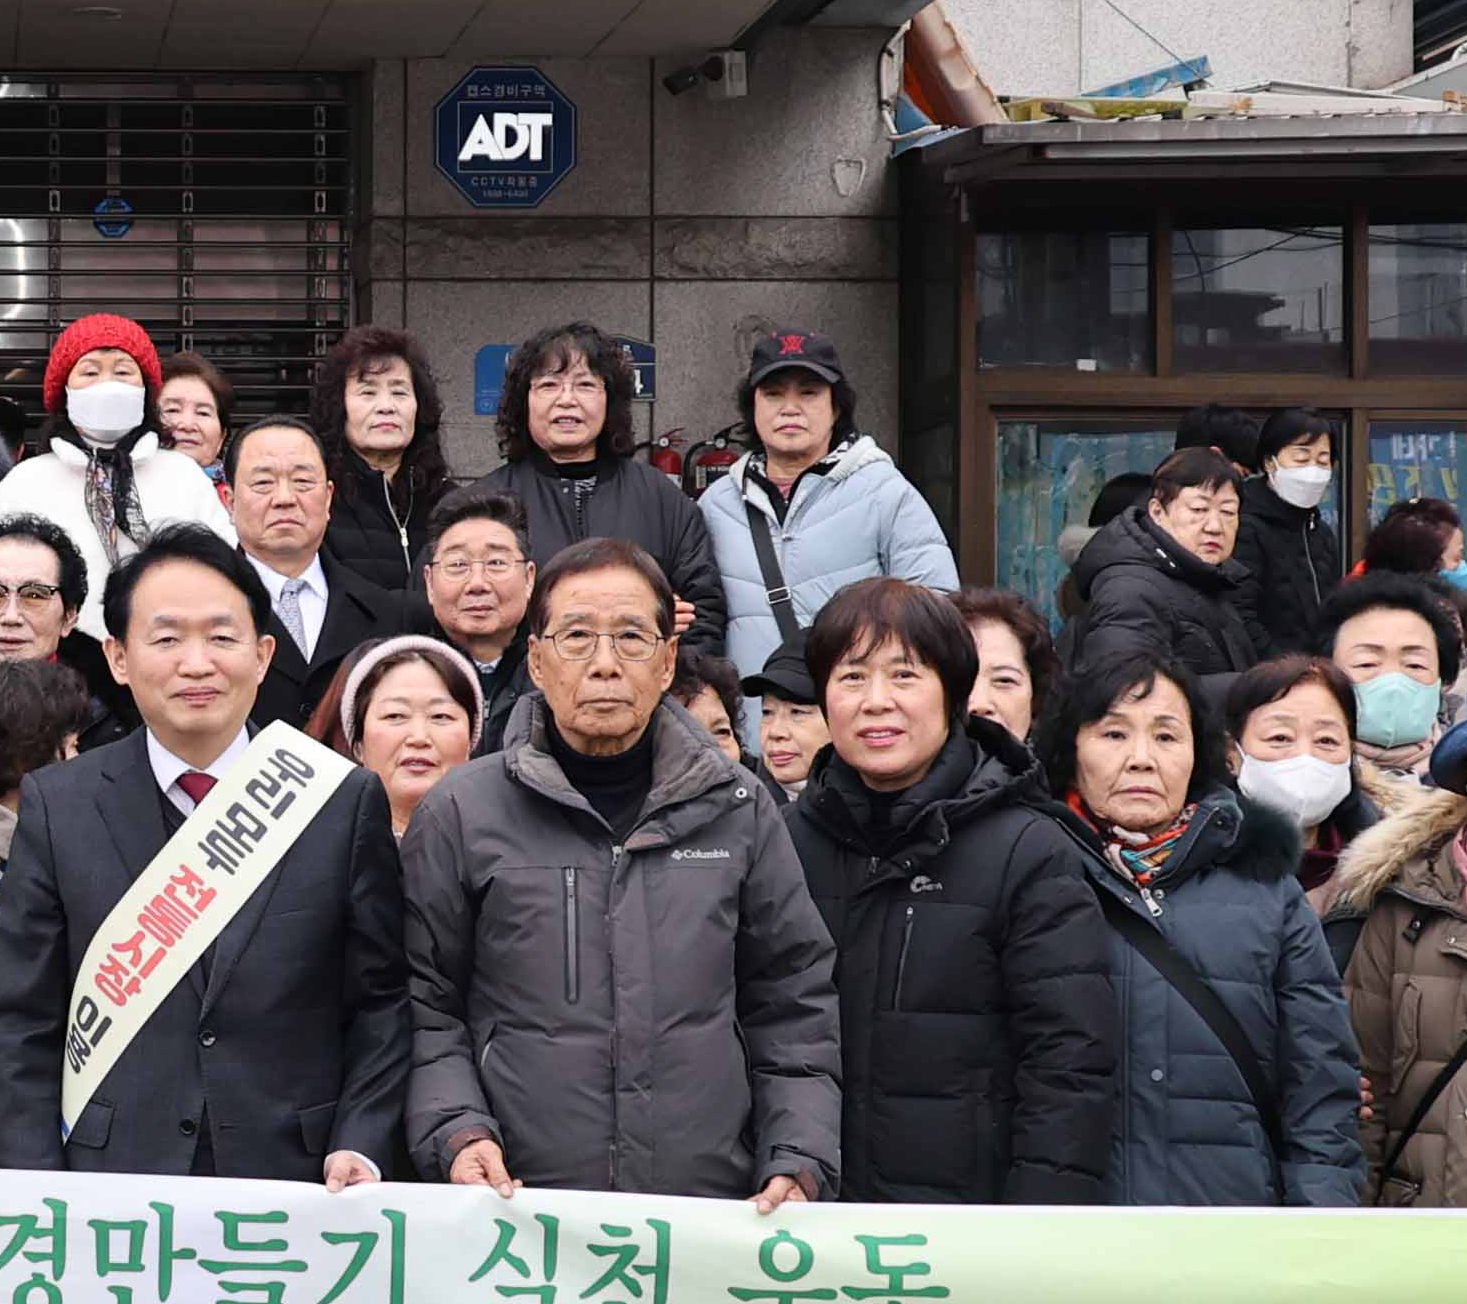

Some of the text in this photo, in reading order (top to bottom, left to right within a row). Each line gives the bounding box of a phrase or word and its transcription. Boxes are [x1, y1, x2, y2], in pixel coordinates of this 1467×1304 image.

[457, 111, 554, 162] ADT
[245, 747, 316, 820] 우리
[197, 801, 270, 876] 모두
[683, 848, 730, 860] Columbia
[93, 863, 218, 1008] 전통시장
